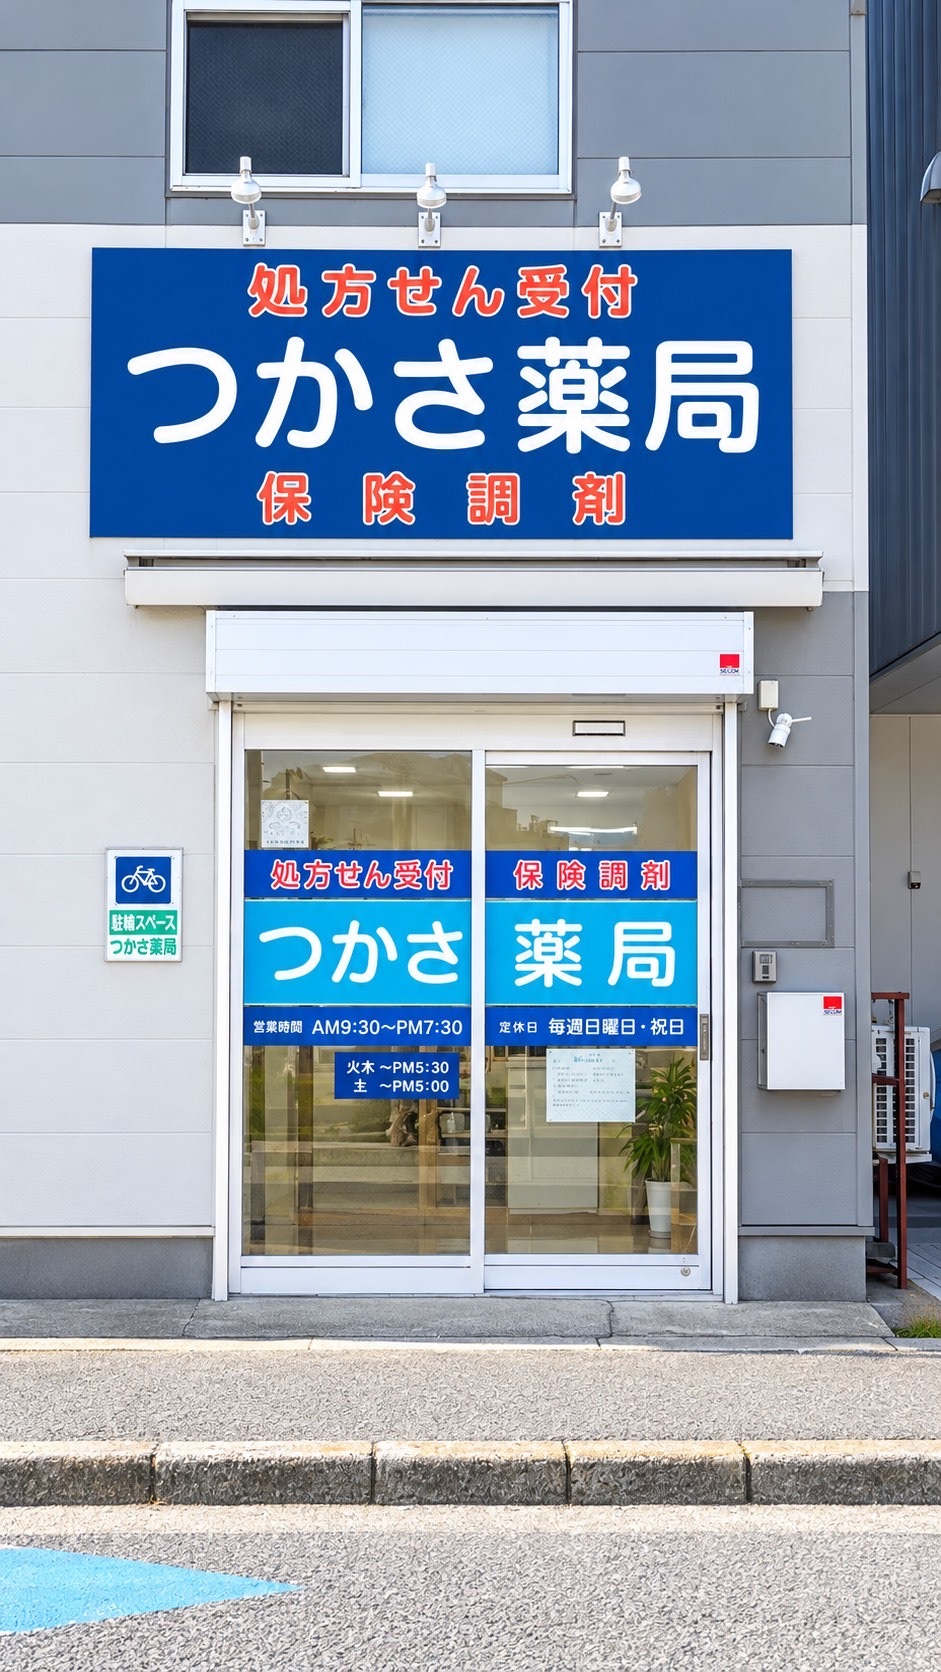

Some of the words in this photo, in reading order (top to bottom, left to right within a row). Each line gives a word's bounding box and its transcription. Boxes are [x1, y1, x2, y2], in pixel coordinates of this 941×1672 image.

[247, 262, 638, 319] 処方せん受付
[127, 336, 760, 455] つかさ薬局
[256, 470, 626, 526] 保険調剤
[270, 859, 454, 891] 処方せん受付
[513, 859, 671, 891] 保険調剤
[110, 937, 177, 956] つかさ薬局
[259, 919, 463, 985] つかさ
[514, 918, 676, 988] 薬局
[253, 1020, 303, 1034] 営業時間
[499, 1021, 537, 1034] 定休日
[548, 1017, 684, 1036] 毎週日曜日・祝日
[346, 1059, 375, 1075] 火木
